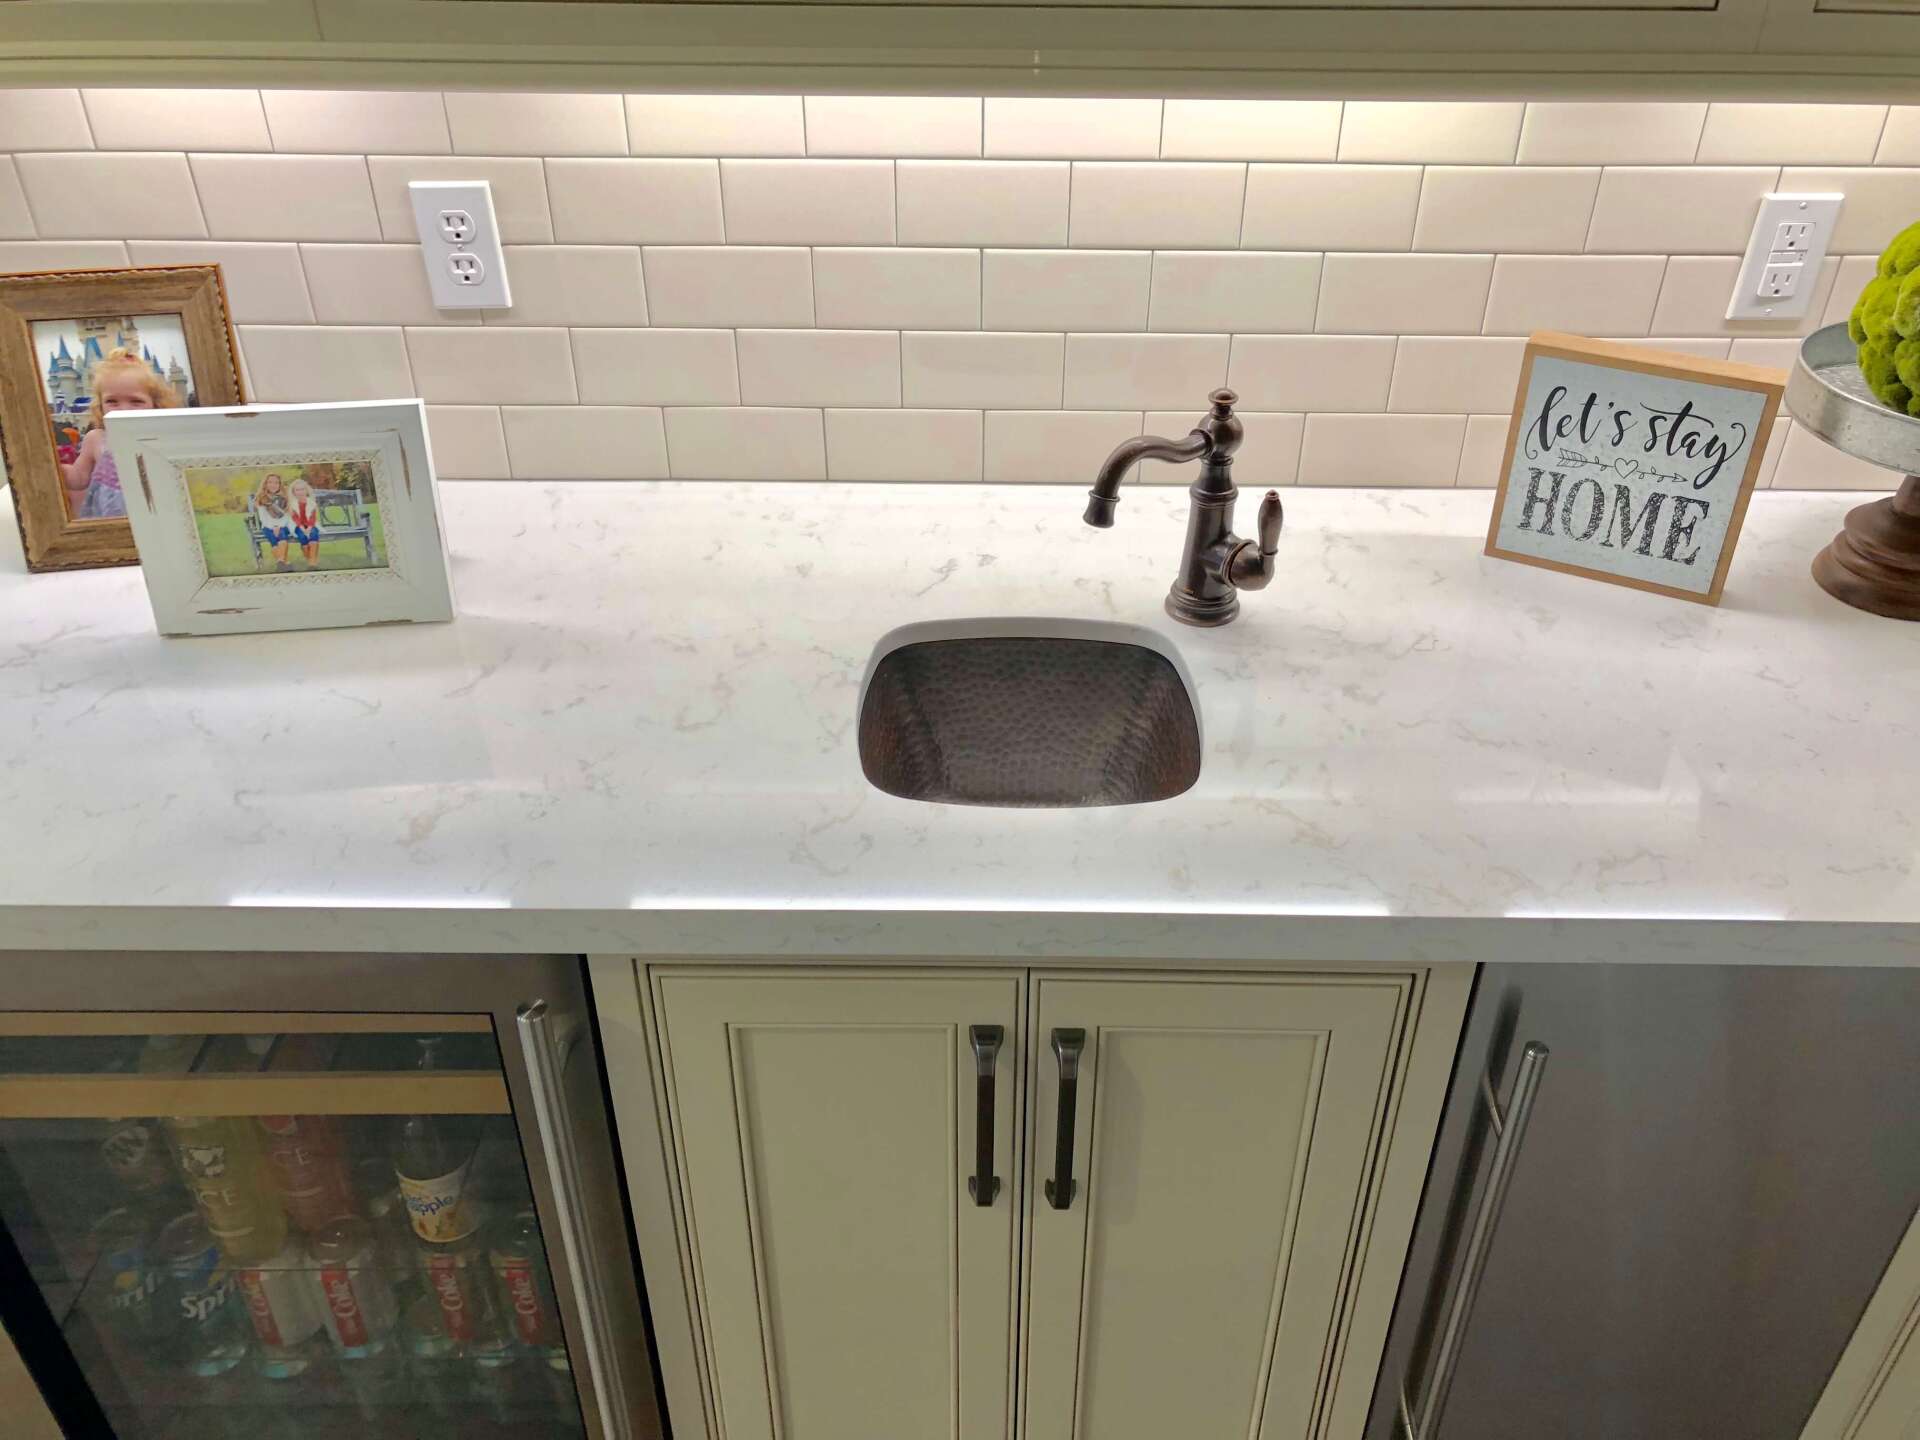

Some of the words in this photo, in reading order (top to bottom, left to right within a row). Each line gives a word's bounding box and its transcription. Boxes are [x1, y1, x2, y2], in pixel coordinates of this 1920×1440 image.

[1525, 386, 1637, 459] let's
[1640, 401, 1746, 490] stay
[1516, 467, 1710, 565] HOME
[405, 1194, 454, 1216] pple
